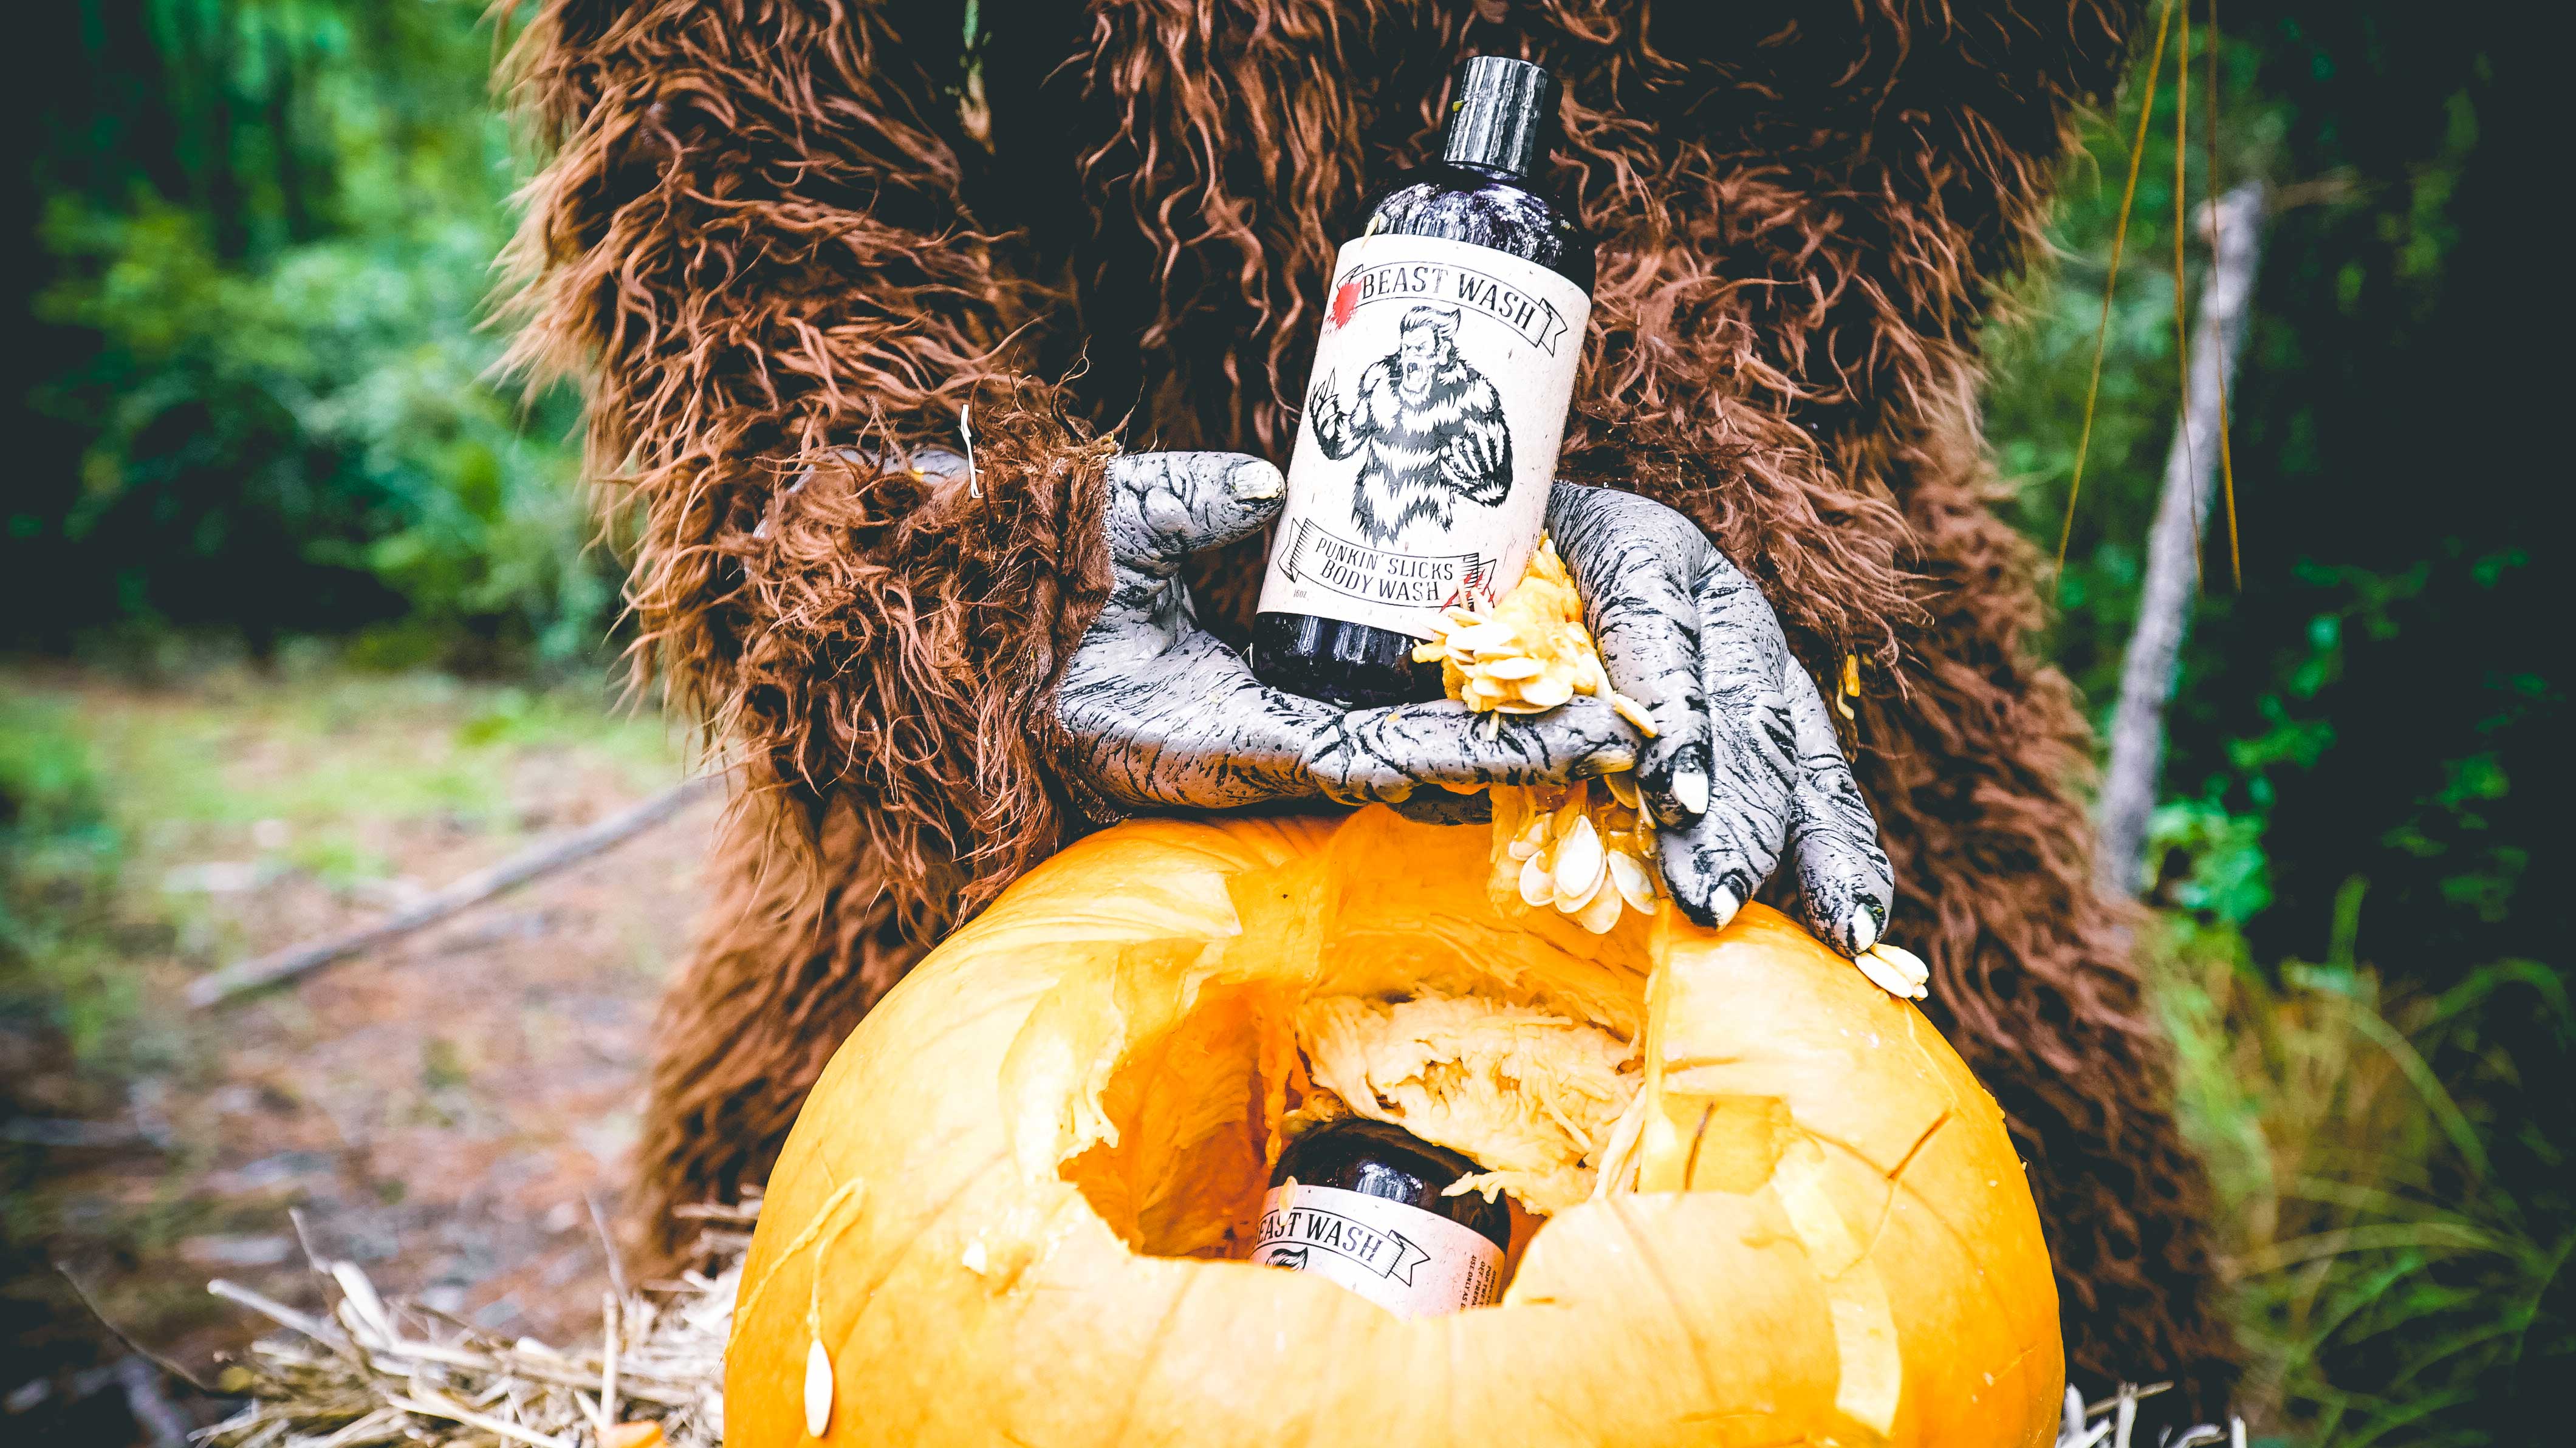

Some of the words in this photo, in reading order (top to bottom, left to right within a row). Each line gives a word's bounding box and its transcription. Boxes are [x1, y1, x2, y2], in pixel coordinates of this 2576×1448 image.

[1362, 266, 1448, 300] BEAST
[1459, 272, 1536, 332] WASH
[1316, 538, 1385, 570] PUNKIN'
[1388, 558, 1453, 581] SLICKS
[1320, 559, 1374, 594] BODY
[1379, 579, 1440, 601] WASH
[1255, 1212, 1301, 1246] EAST
[1306, 1214, 1383, 1263] WASH
[1471, 1280, 1481, 1306] PREPA
